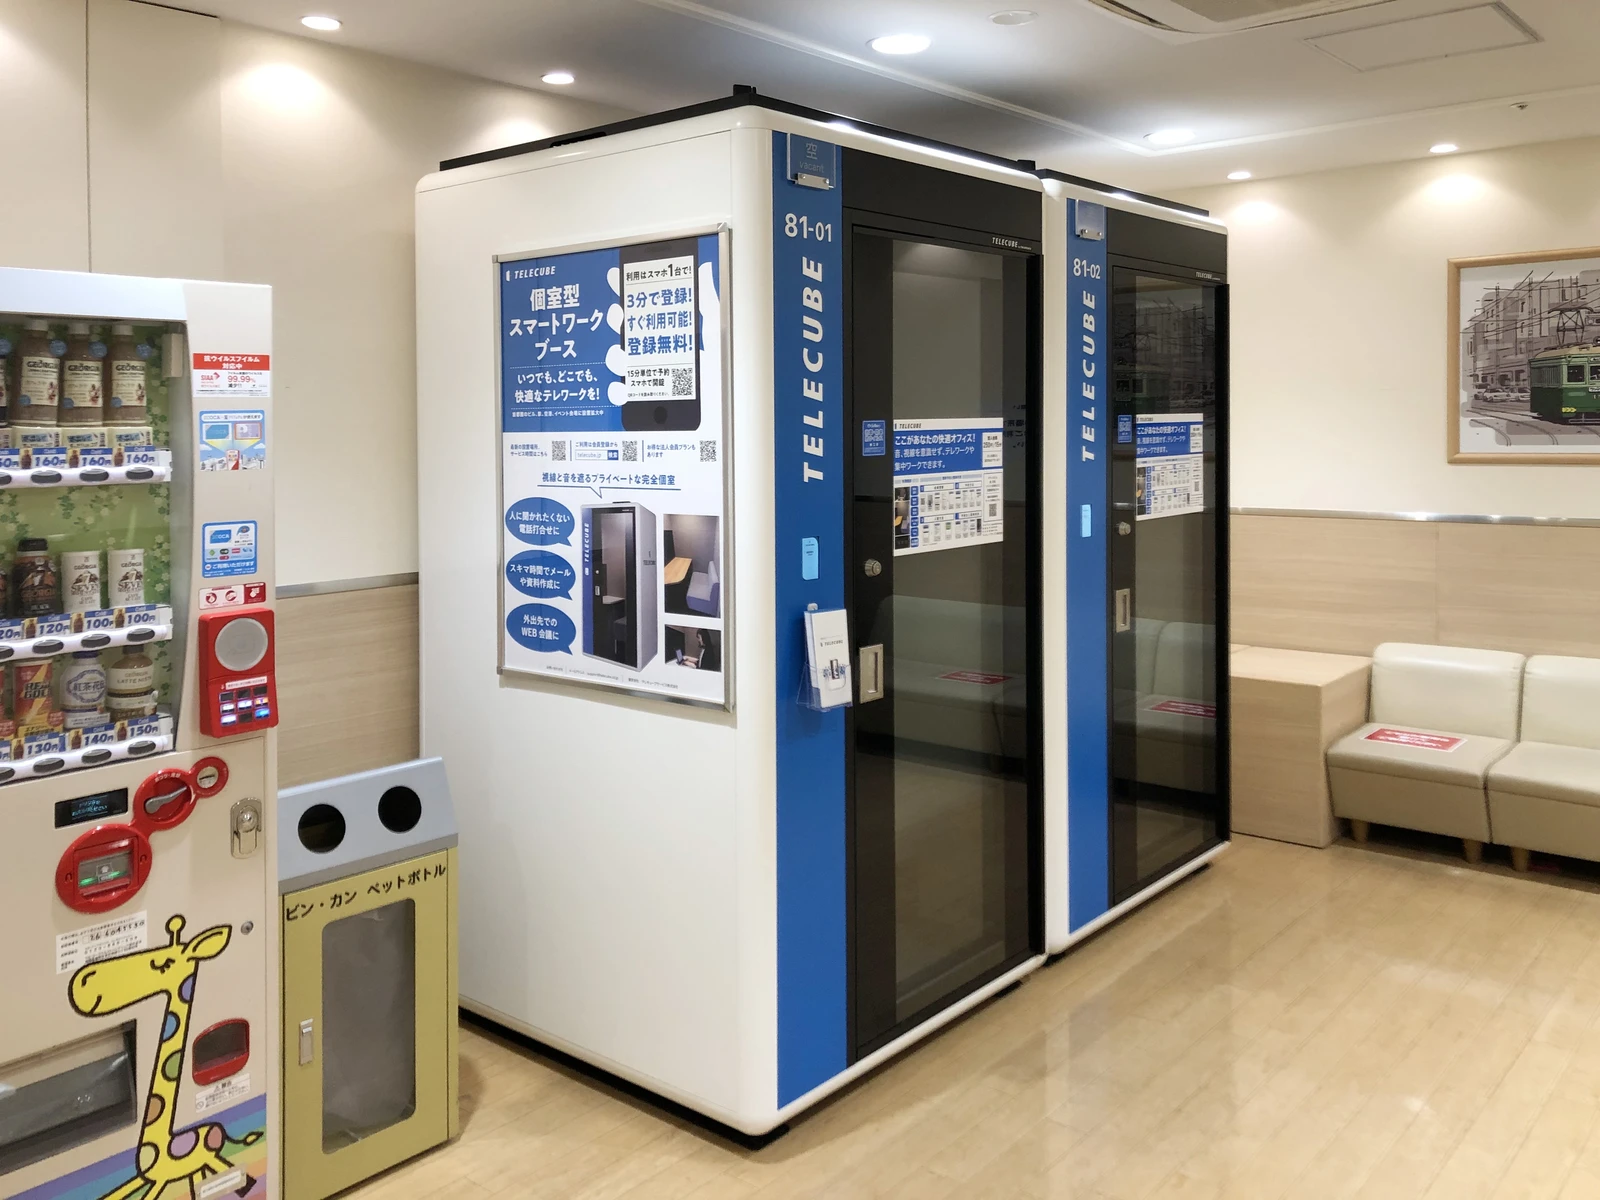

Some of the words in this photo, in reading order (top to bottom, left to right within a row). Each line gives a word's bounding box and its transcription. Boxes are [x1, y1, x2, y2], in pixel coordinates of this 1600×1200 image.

[799, 160, 825, 174] vacant
[784, 212, 832, 243] 81-01
[991, 236, 1018, 248] TELECUBE
[513, 265, 556, 280] TELECUBE
[1072, 258, 1101, 279] 81-02
[529, 283, 581, 312] 個室型
[626, 287, 693, 309] 3分で登録!
[509, 308, 604, 337] スマートワーク
[627, 311, 693, 332] すぐ利用可能!
[534, 338, 577, 361] ブース
[627, 334, 693, 356] 登録無料!
[517, 369, 598, 384] いつでも、どこでも、
[627, 368, 670, 378] 15分単位で予約
[802, 256, 824, 483] TELECUBE
[1082, 290, 1096, 462] TELECUBE
[514, 386, 600, 404] 快適なテレワークを!
[126, 453, 155, 464] 160円
[541, 471, 676, 486] 視線と音を遮るプライベートな完全個室
[509, 510, 571, 523] 人に聞かれたくない
[518, 522, 560, 536] 電話打合せに
[509, 563, 572, 578] スキマ時間でメール
[519, 576, 561, 590] や資料作成に
[127, 613, 156, 625] 100円
[522, 613, 558, 627] 外出先での
[521, 627, 538, 640] WEB
[538, 628, 560, 641] 会議に
[129, 724, 159, 736] 150円
[84, 733, 114, 746] 140円
[27, 742, 59, 755] 130円
[285, 890, 357, 921] ビン・カン
[366, 864, 447, 895] ペットボトル
